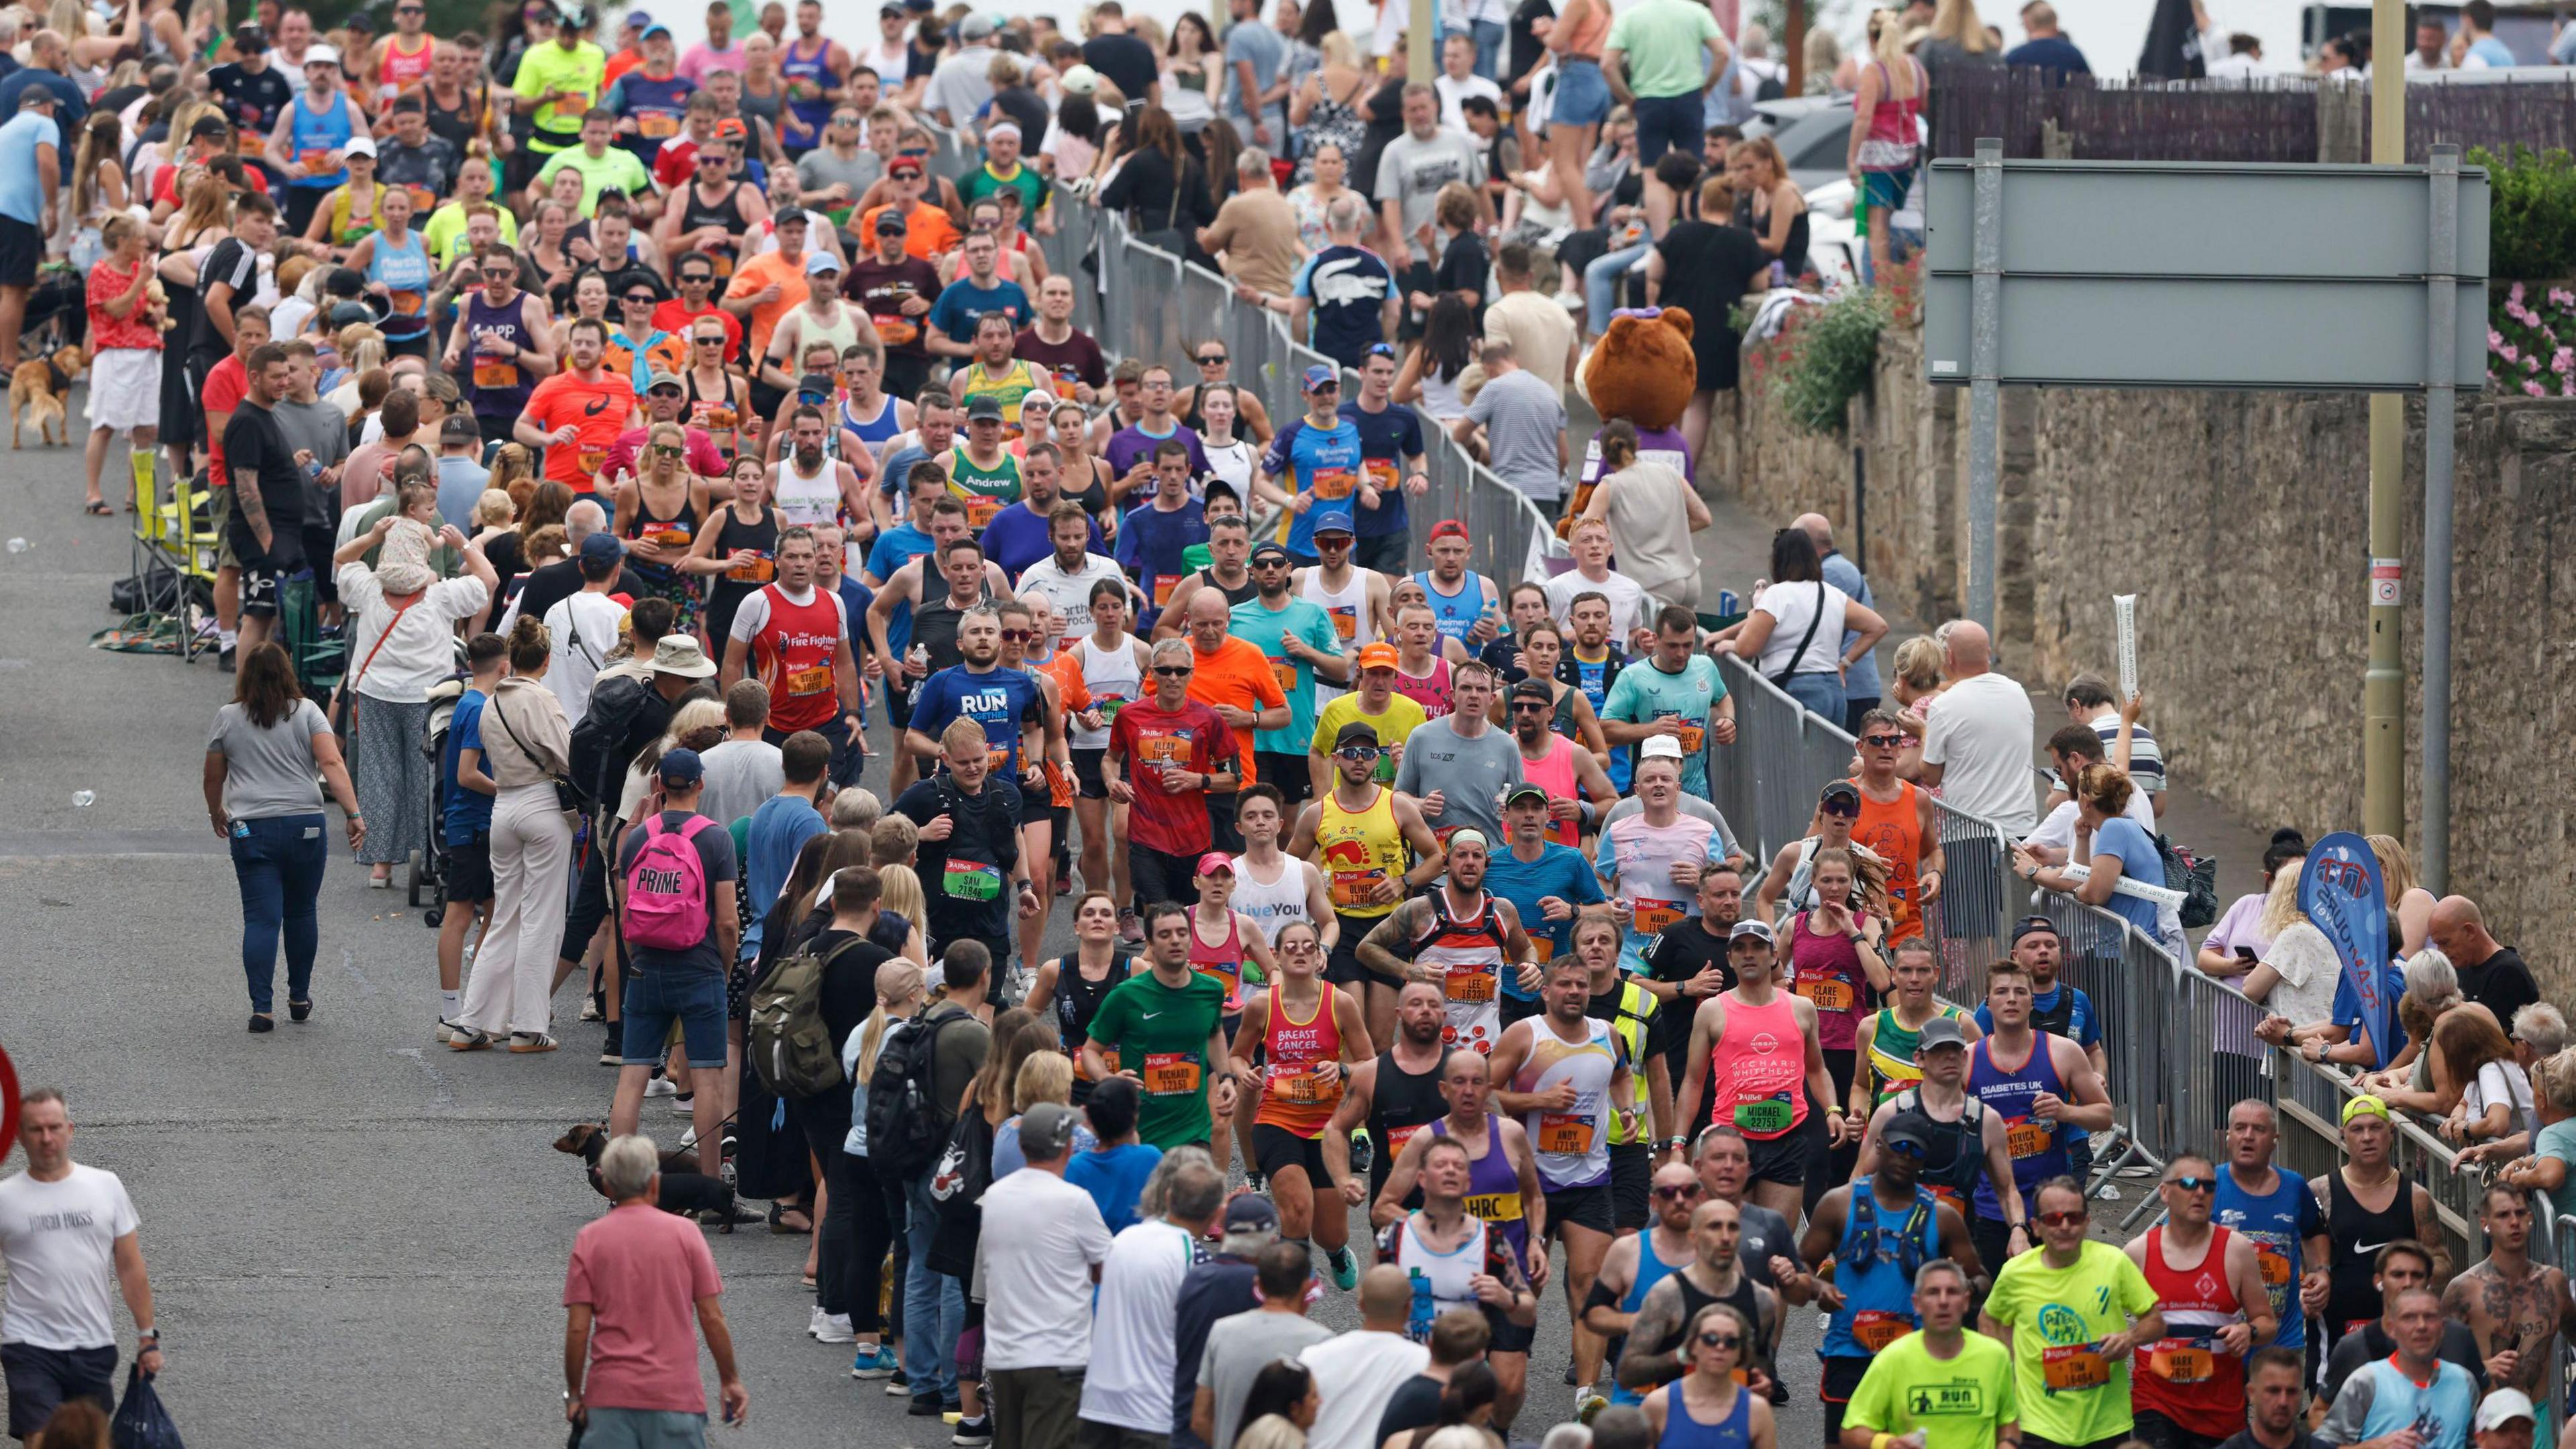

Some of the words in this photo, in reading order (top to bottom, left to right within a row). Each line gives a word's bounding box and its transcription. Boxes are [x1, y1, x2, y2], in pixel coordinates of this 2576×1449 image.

[966, 476, 1012, 488] Andrew
[781, 498, 806, 507] derian
[791, 637, 808, 646] Fire
[961, 694, 1008, 714] RUN
[1154, 741, 1175, 751] ALLAN
[1339, 826, 1348, 835] &
[954, 863, 972, 871] AJBell
[636, 867, 683, 895] PRIME
[963, 875, 980, 887] SAM
[957, 885, 983, 898] 21946
[1642, 901, 1658, 909] AJBell
[1650, 913, 1669, 924] MARK
[1455, 966, 1472, 974] AJBell
[1804, 972, 1823, 981] AJBell
[1468, 979, 1481, 989] LEE
[1813, 985, 1837, 996] CLARE
[1277, 1029, 1318, 1042] BREAST
[1277, 1040, 1321, 1051] CANCER
[1279, 1051, 1303, 1061] NOW
[1150, 1057, 1171, 1066] AJBell
[1731, 1059, 1796, 1069] RICHARD
[1157, 1069, 1190, 1080] RICHARD
[1733, 1067, 1796, 1077] WHITEHEAD
[1291, 1079, 1316, 1089] GRACE
[2028, 1081, 2043, 1090] UK
[1746, 1093, 1762, 1102] AJBell
[1747, 1106, 1781, 1117] MICHAEL
[1751, 1117, 1776, 1128] 22755
[1556, 1130, 1578, 1140] ANDY
[2008, 1130, 2036, 1145] ATRICK
